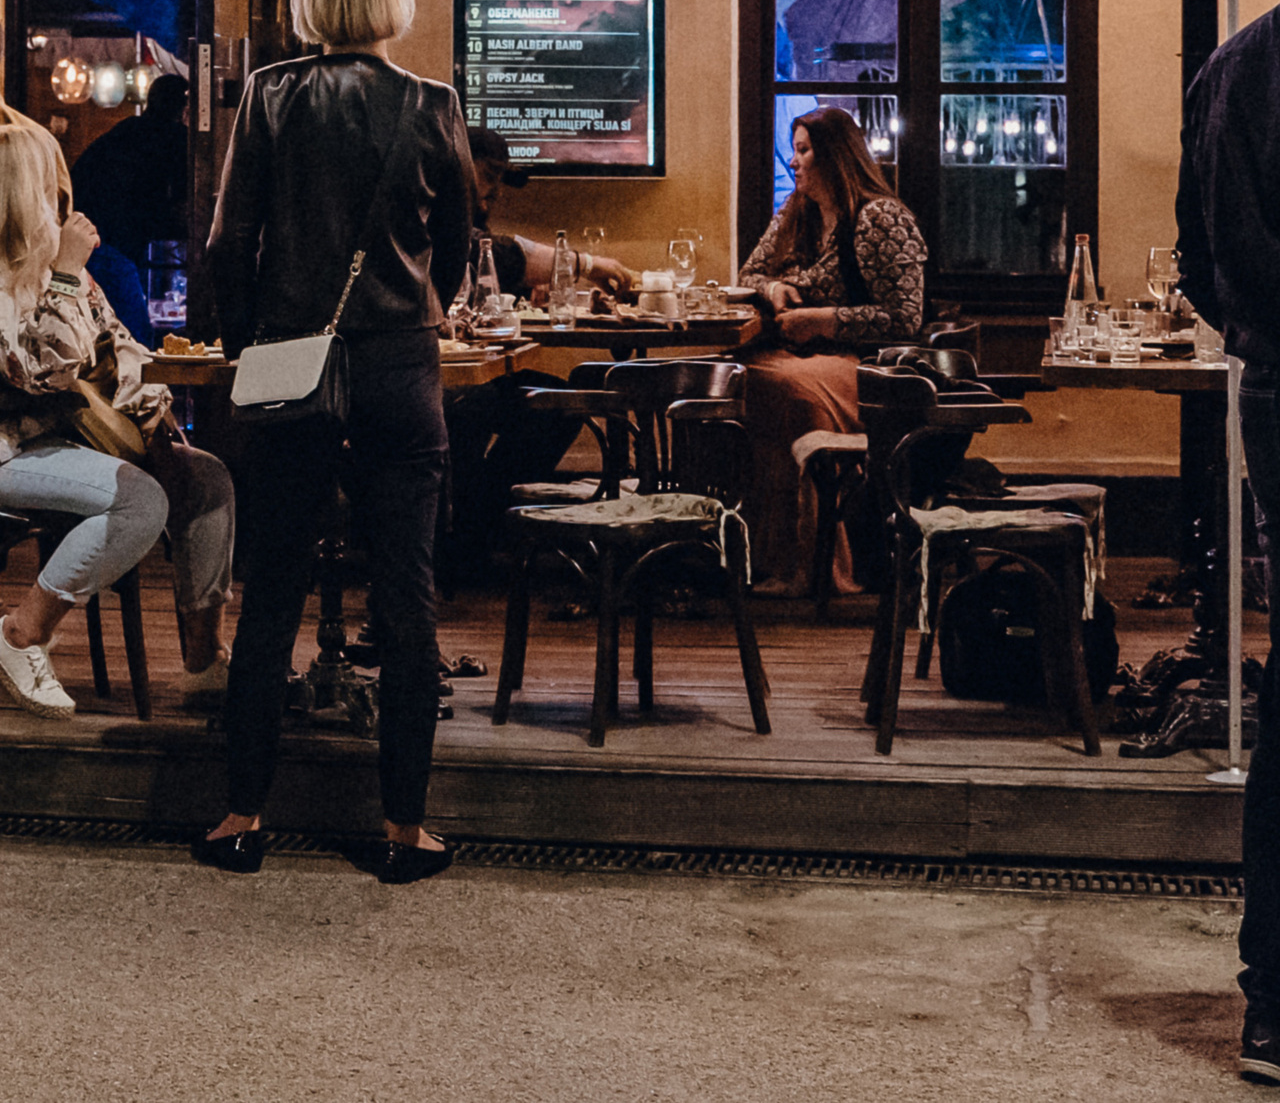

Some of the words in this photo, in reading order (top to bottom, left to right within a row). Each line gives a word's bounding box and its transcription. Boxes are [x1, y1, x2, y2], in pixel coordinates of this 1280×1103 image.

[471, 7, 480, 19] 9
[467, 41, 483, 53] 10
[488, 39, 514, 50] NASH
[515, 39, 555, 51] ALBERT
[556, 40, 583, 51] BAND
[467, 74, 481, 86] 11
[487, 73, 517, 84] GYPSY
[519, 73, 545, 84] JACK
[467, 109, 481, 119] 12
[525, 108, 557, 119] ЗВЕРИ
[558, 108, 566, 119] И
[567, 108, 604, 120] ПТИЦЫ
[547, 120, 593, 131] КОНЦЕРТ
[594, 120, 619, 131] SLUA
